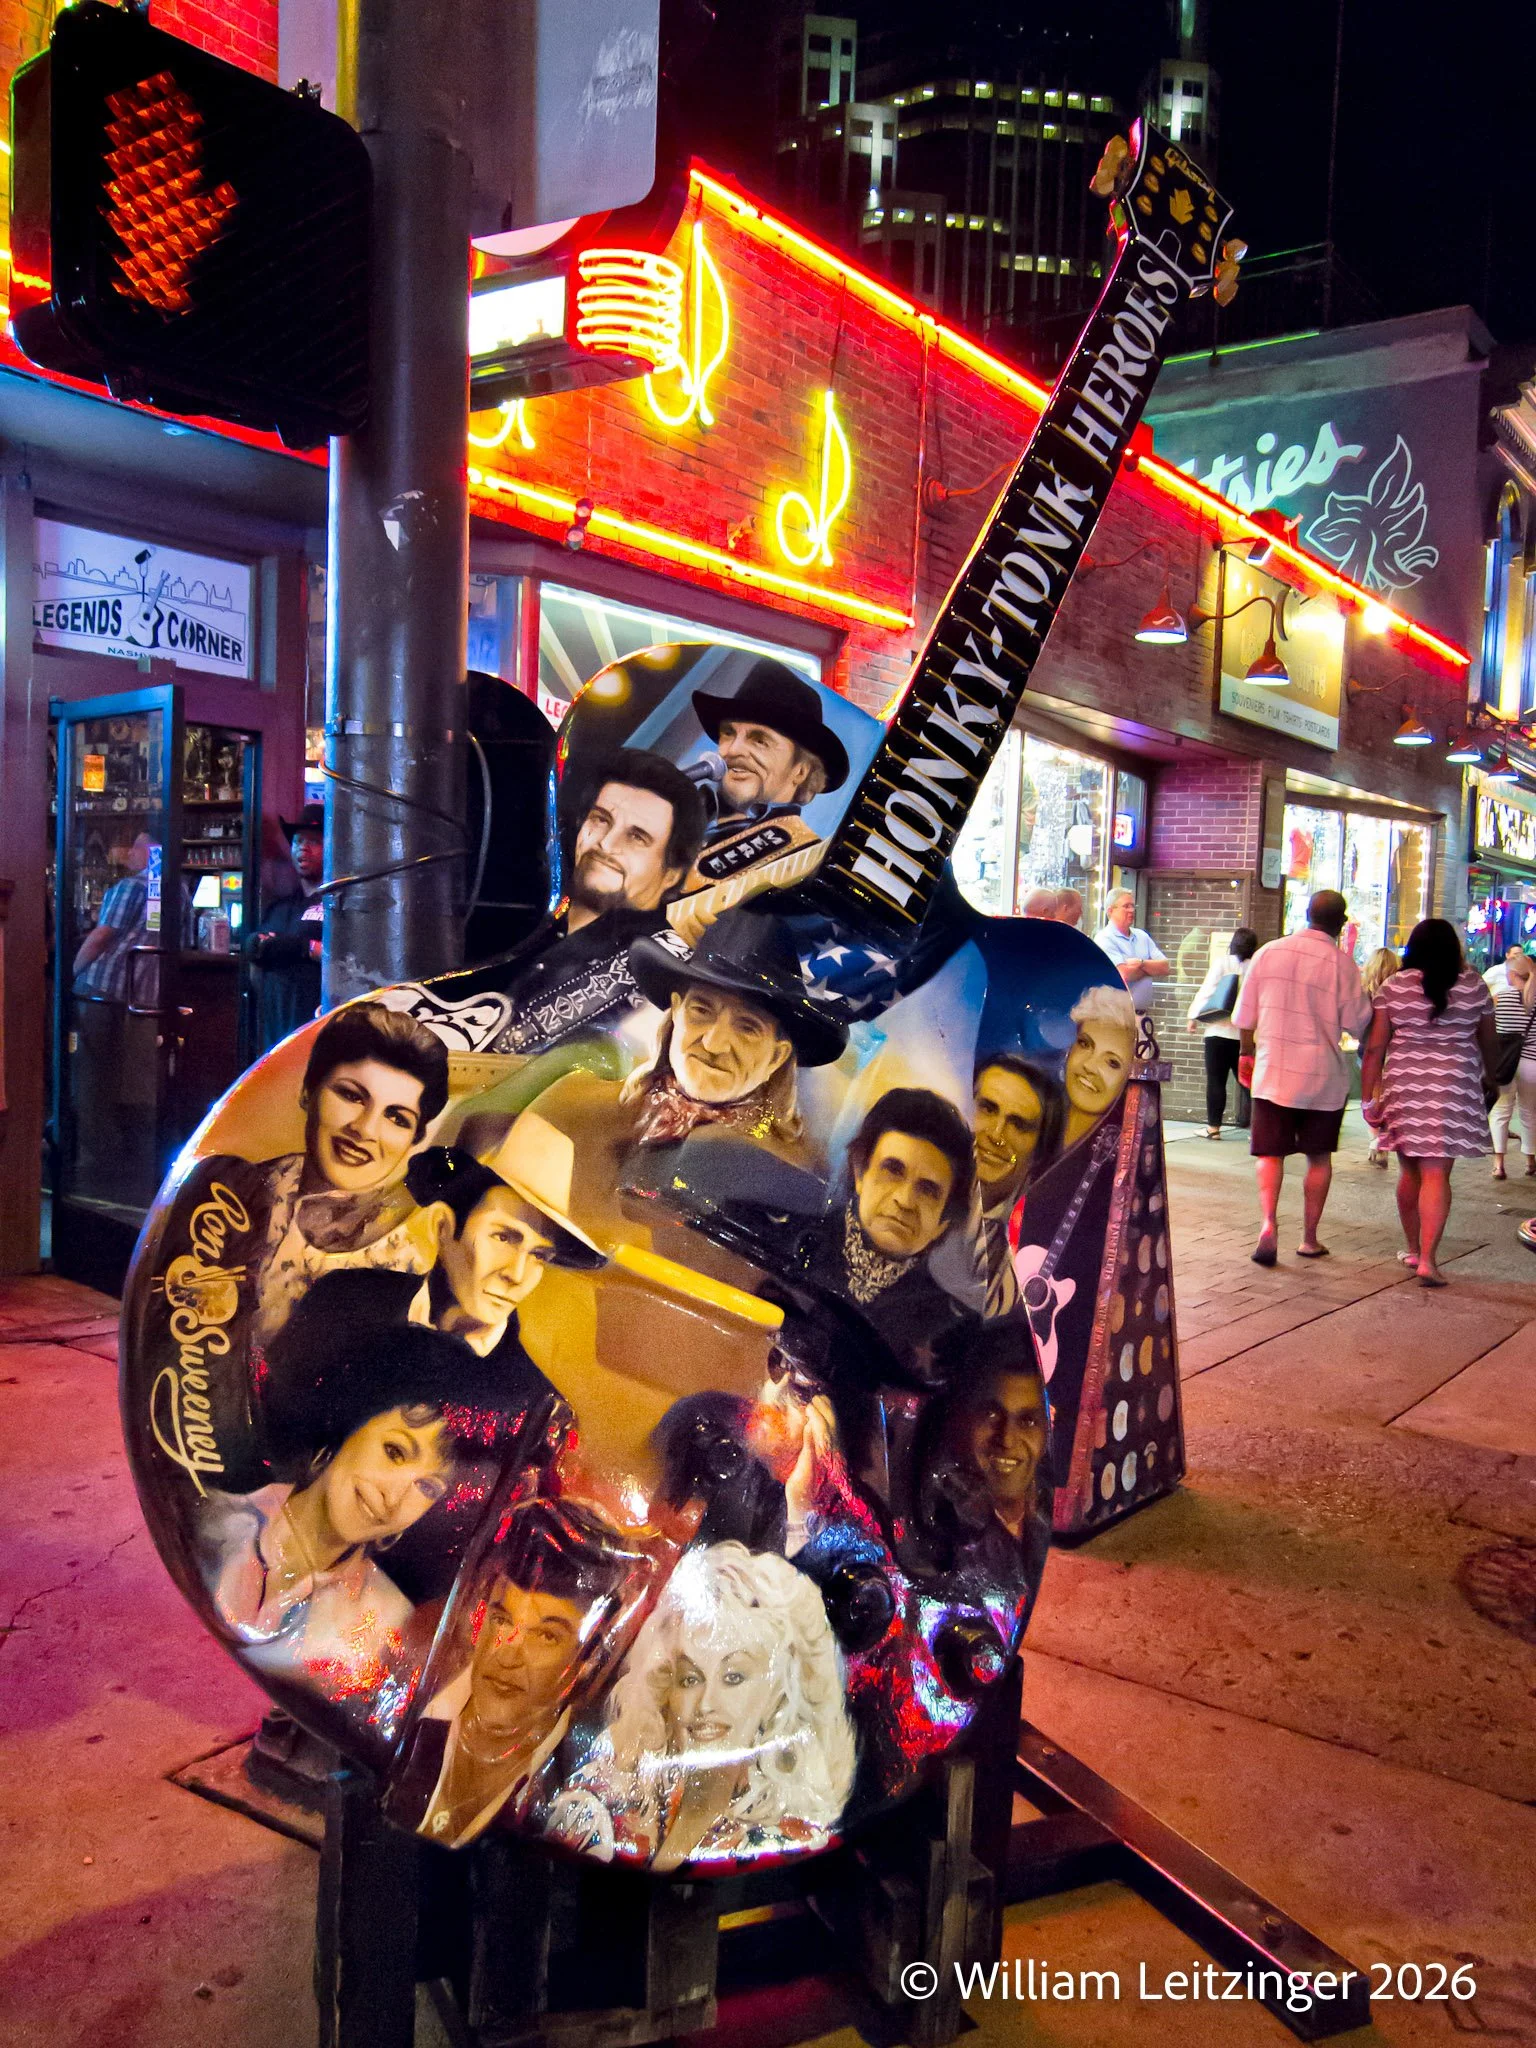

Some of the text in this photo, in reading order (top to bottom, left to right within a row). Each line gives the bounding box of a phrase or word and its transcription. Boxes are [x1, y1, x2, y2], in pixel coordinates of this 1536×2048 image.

[167, 611, 243, 662] CORNER
[853, 254, 1179, 908] HONKY-TONK HEROES
[189, 1181, 250, 1262] Ron
[151, 1306, 231, 1498] Sweeney
